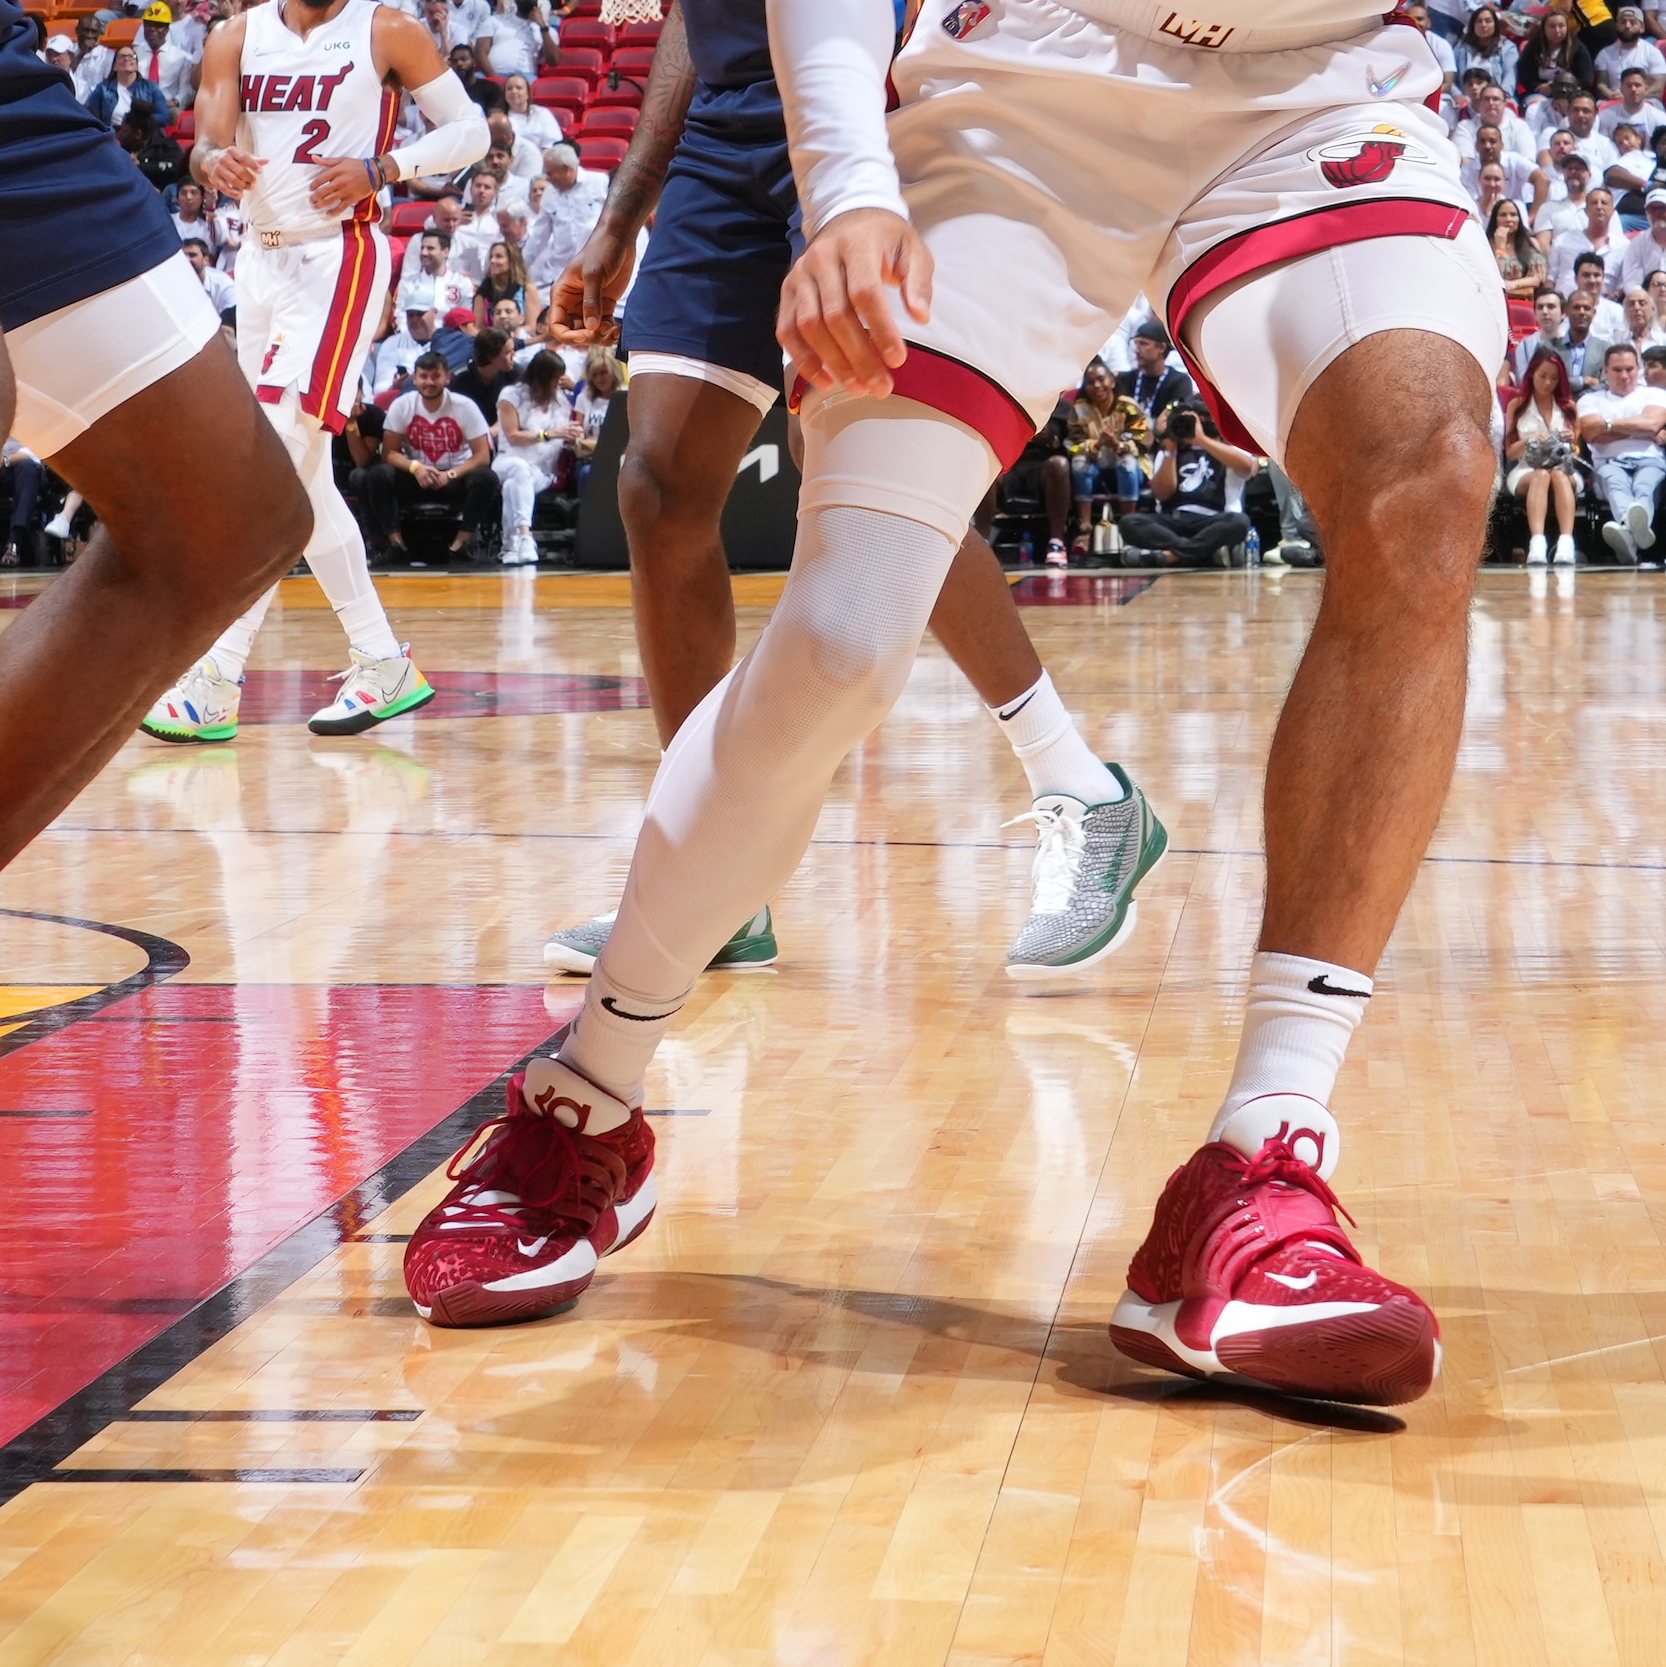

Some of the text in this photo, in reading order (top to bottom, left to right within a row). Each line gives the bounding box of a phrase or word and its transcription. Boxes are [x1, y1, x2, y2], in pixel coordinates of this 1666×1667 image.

[322, 40, 351, 51] UKG
[240, 60, 355, 113] HEAT
[292, 118, 332, 164] 2
